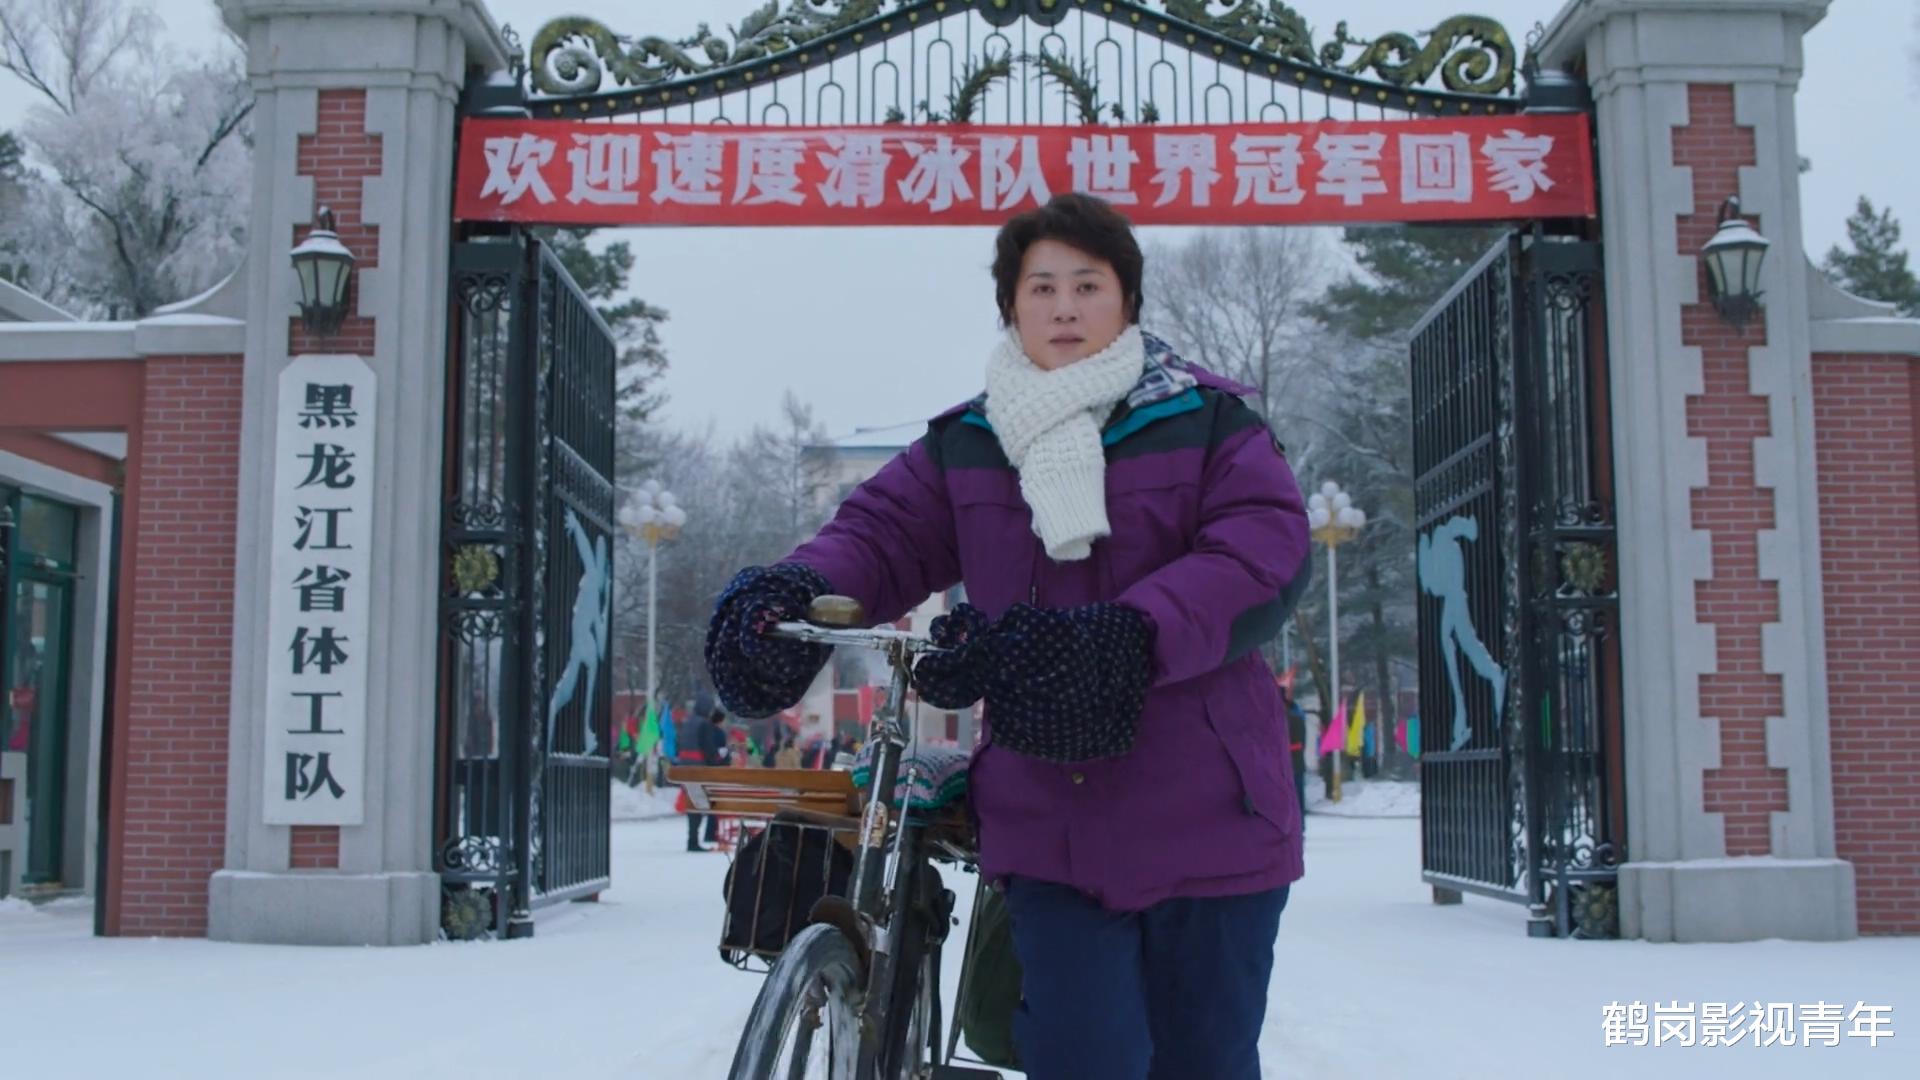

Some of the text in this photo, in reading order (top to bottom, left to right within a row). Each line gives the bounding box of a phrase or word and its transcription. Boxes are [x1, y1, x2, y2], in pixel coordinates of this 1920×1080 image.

[480, 129, 1555, 212] 欢迎速度滑冰队世界冠军回家
[284, 382, 358, 801] 黑龙江省体工队
